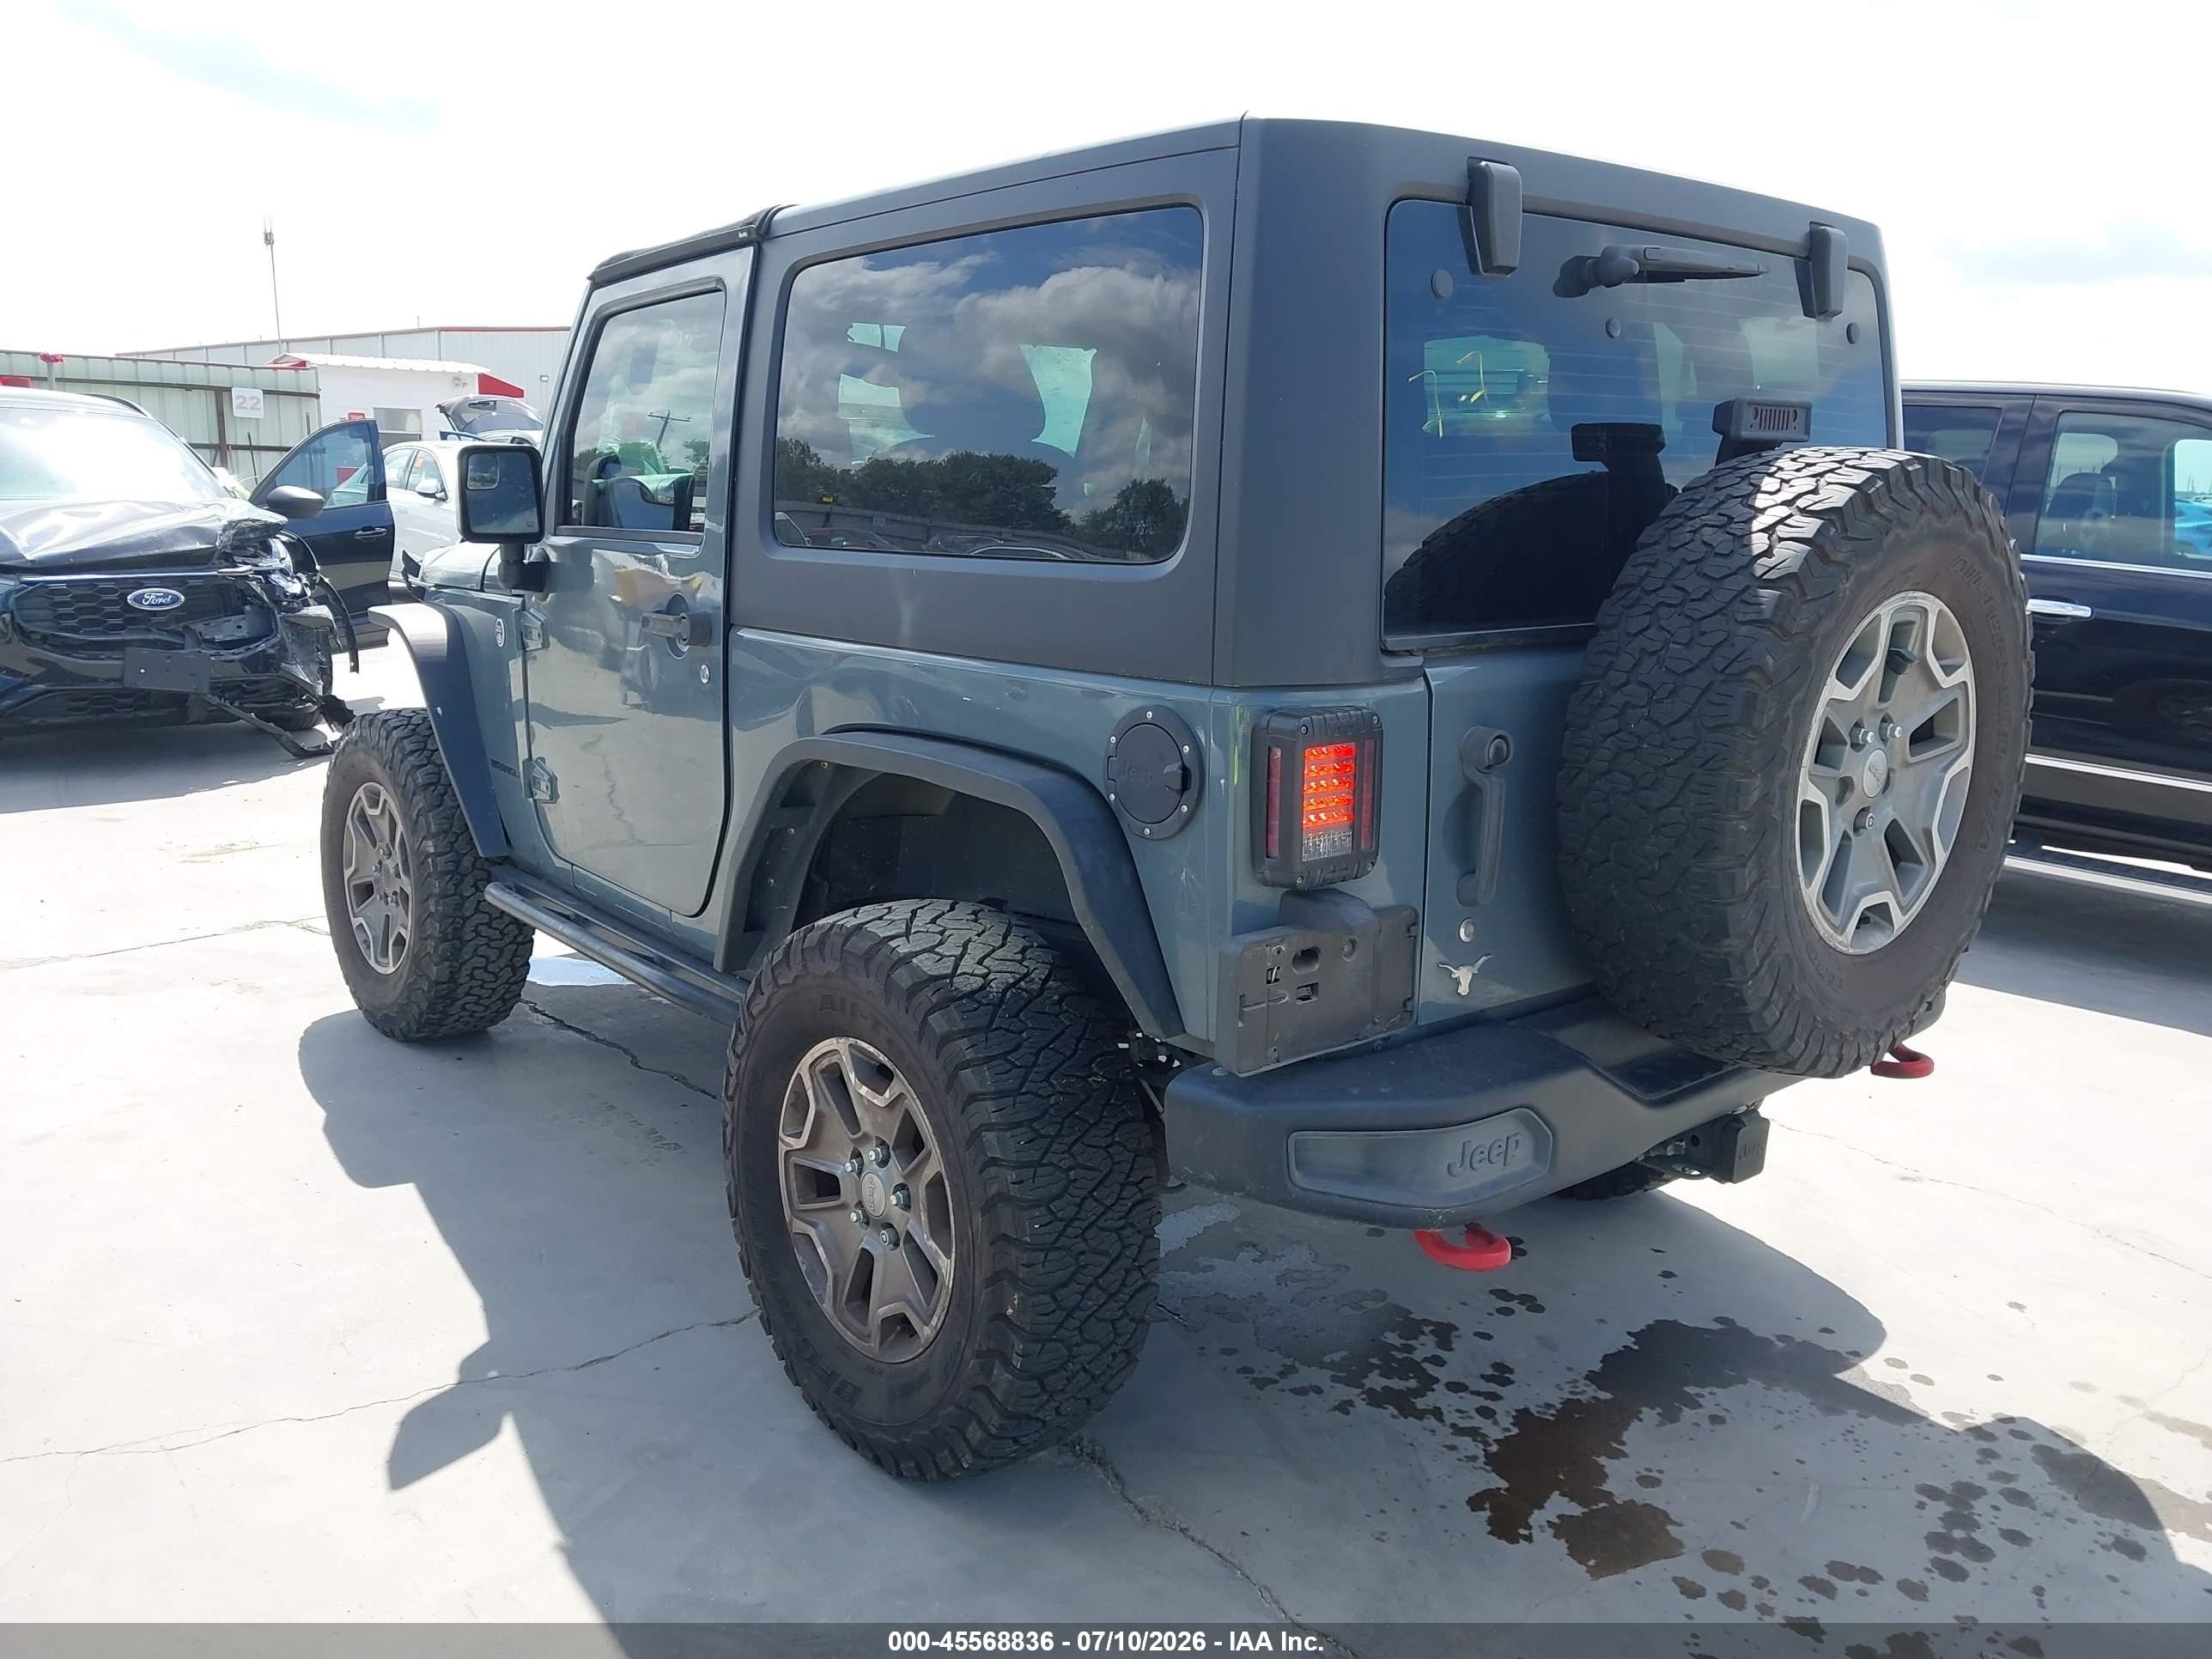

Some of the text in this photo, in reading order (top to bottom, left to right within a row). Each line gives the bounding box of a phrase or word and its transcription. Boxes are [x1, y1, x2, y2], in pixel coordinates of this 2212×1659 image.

[234, 395, 262, 411] 22
[142, 592, 173, 605] Ford
[1446, 1132, 1521, 1177] Jeep
